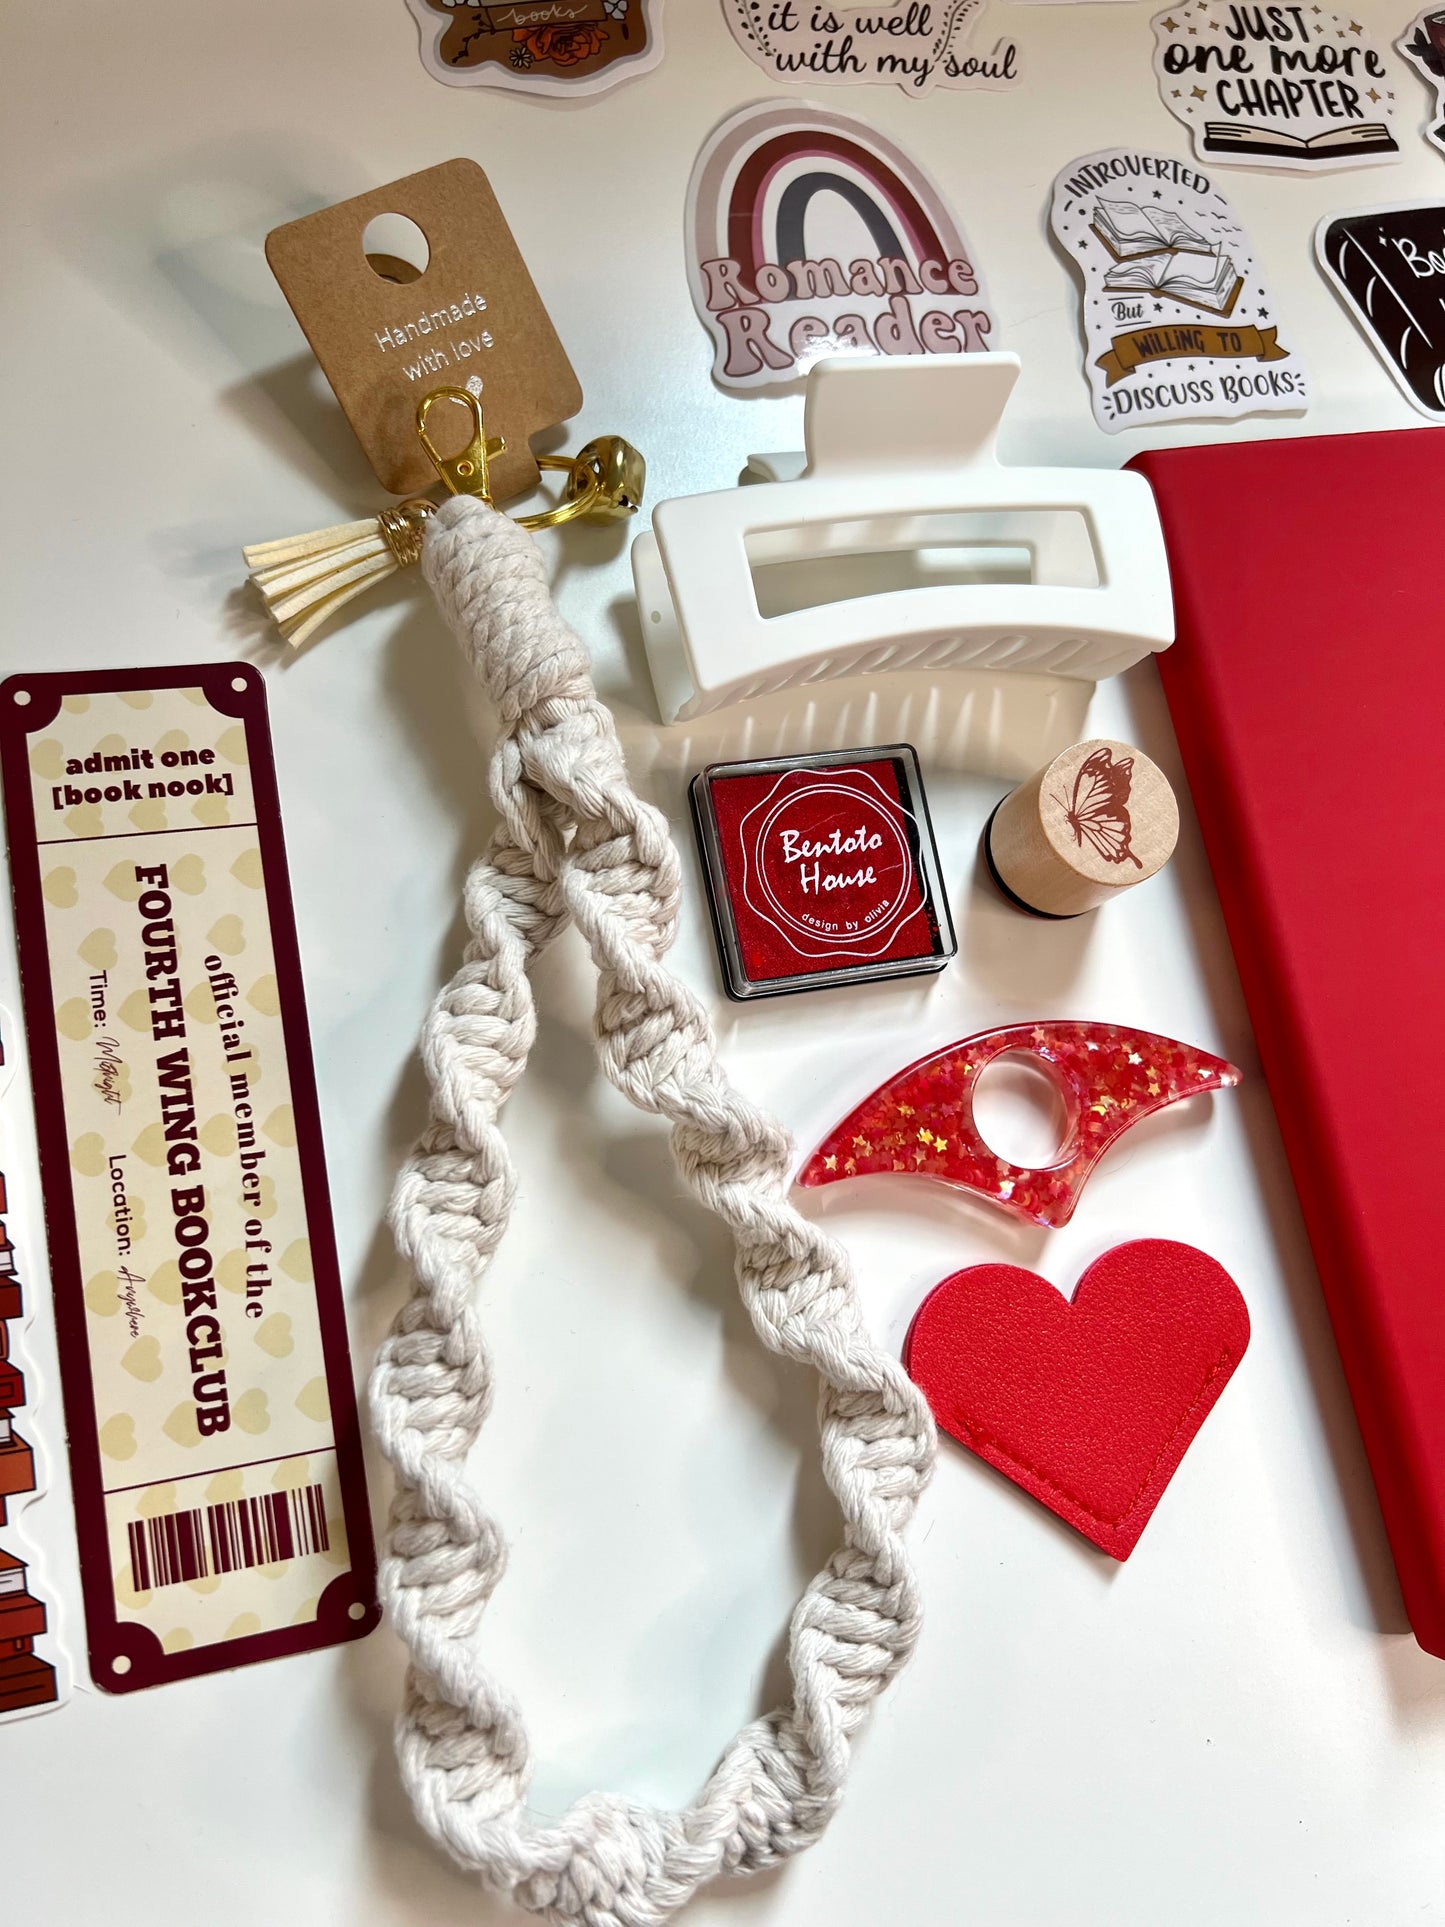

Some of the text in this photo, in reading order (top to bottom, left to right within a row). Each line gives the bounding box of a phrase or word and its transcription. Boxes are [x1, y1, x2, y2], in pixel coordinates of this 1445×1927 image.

[497, 5, 588, 25] books
[768, 1, 933, 36] it is well
[1225, 4, 1310, 43] JUST
[775, 35, 1018, 87] with my soul
[1164, 43, 1386, 78] one more
[1216, 78, 1364, 119] CHAPTER
[1064, 155, 1210, 199] INTROVERTED
[1391, 238, 1445, 278] Bo
[701, 257, 979, 312] Romance
[373, 292, 488, 353] Handmade
[1111, 301, 1144, 321] But
[402, 330, 494, 381] with love
[716, 294, 992, 377] Reader
[1217, 332, 1242, 353] TO
[1113, 370, 1296, 415] DISCUSS BOOKS
[65, 747, 216, 775] admit one
[51, 773, 235, 810] [book nook]
[779, 825, 882, 863] Bentoto
[800, 861, 877, 895] House
[802, 899, 890, 931] design by olivia
[89, 969, 108, 1028] Time:
[134, 863, 231, 1437] FOURTH WING BOOKCLUB
[204, 954, 272, 1319] official member of the
[108, 1154, 133, 1256] Location:
[117, 1265, 146, 1338] Anywhere
